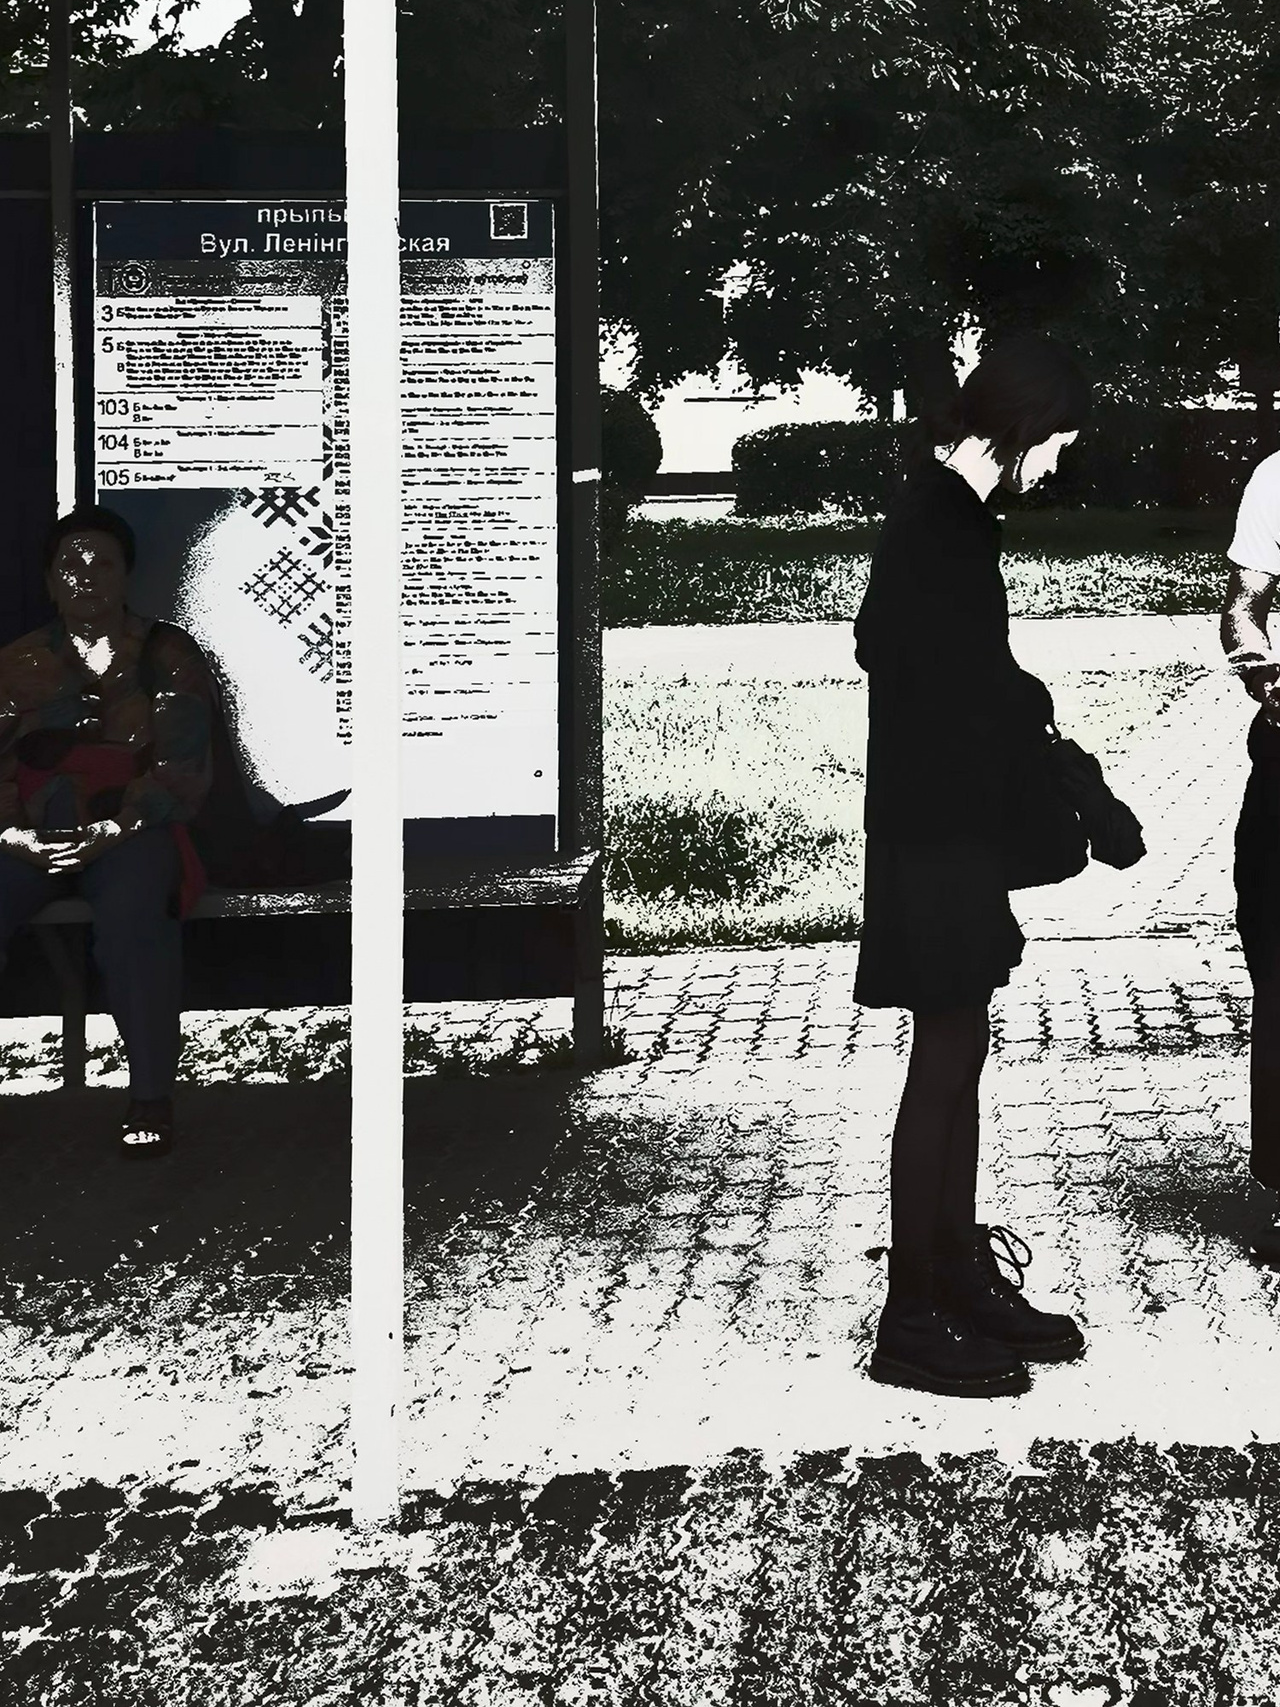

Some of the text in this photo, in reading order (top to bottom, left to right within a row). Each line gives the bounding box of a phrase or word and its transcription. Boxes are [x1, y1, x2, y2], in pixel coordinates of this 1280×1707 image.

[200, 232, 450, 259] Вул. Ленінгская
[101, 304, 114, 323] 3
[101, 336, 114, 354] 5
[97, 398, 130, 416] 103
[97, 433, 130, 451] 104
[97, 468, 130, 487] 105
